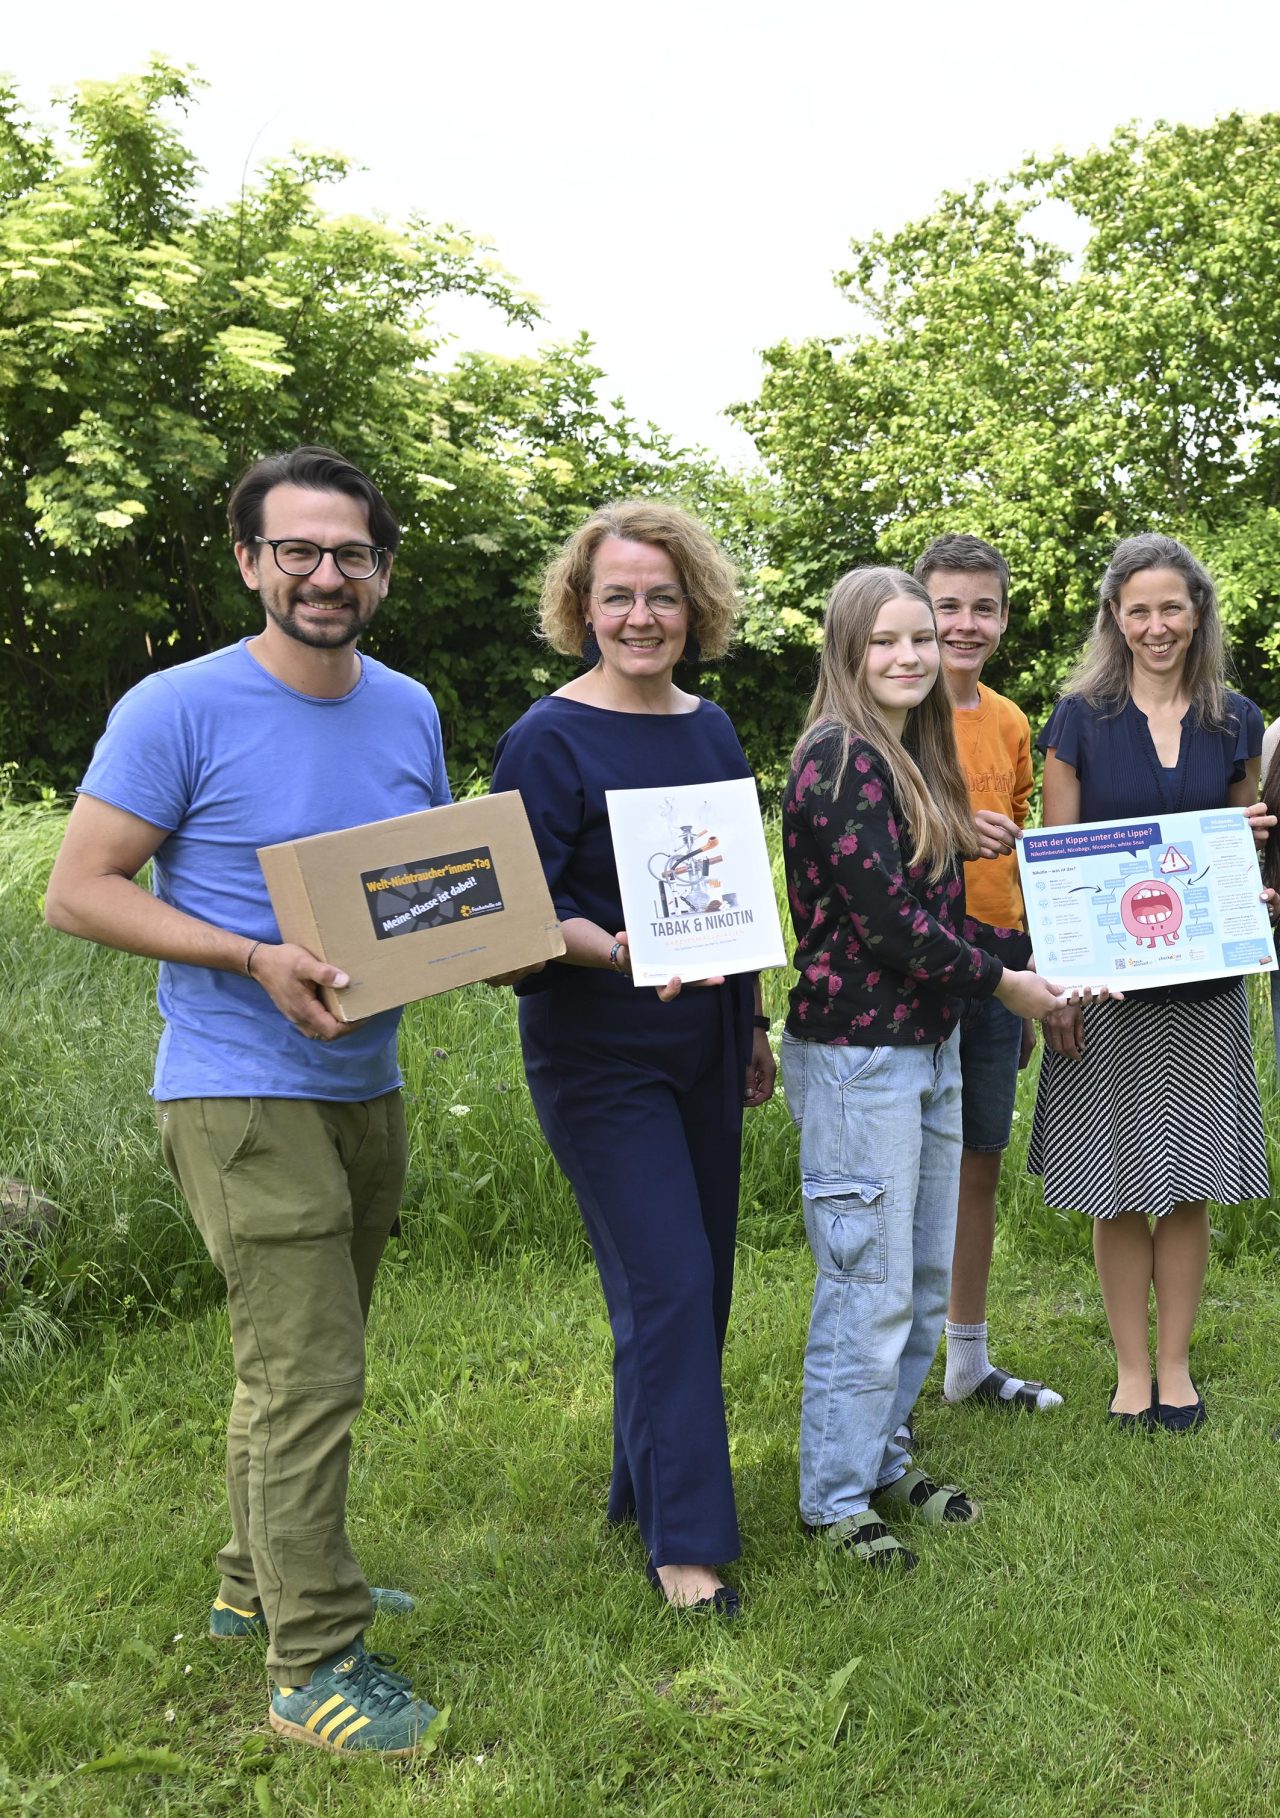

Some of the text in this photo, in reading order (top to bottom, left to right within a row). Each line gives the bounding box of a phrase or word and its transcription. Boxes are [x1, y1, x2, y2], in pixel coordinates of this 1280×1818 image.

[1029, 827, 1153, 849] Statt der Kippe unter die Lippe?
[1067, 845, 1092, 854] Nicobags,
[1092, 843, 1117, 851] Nicopods,
[382, 876, 478, 932] Meine Klasse ist dabei!
[650, 909, 754, 937] TABAK & NIKOTIN
